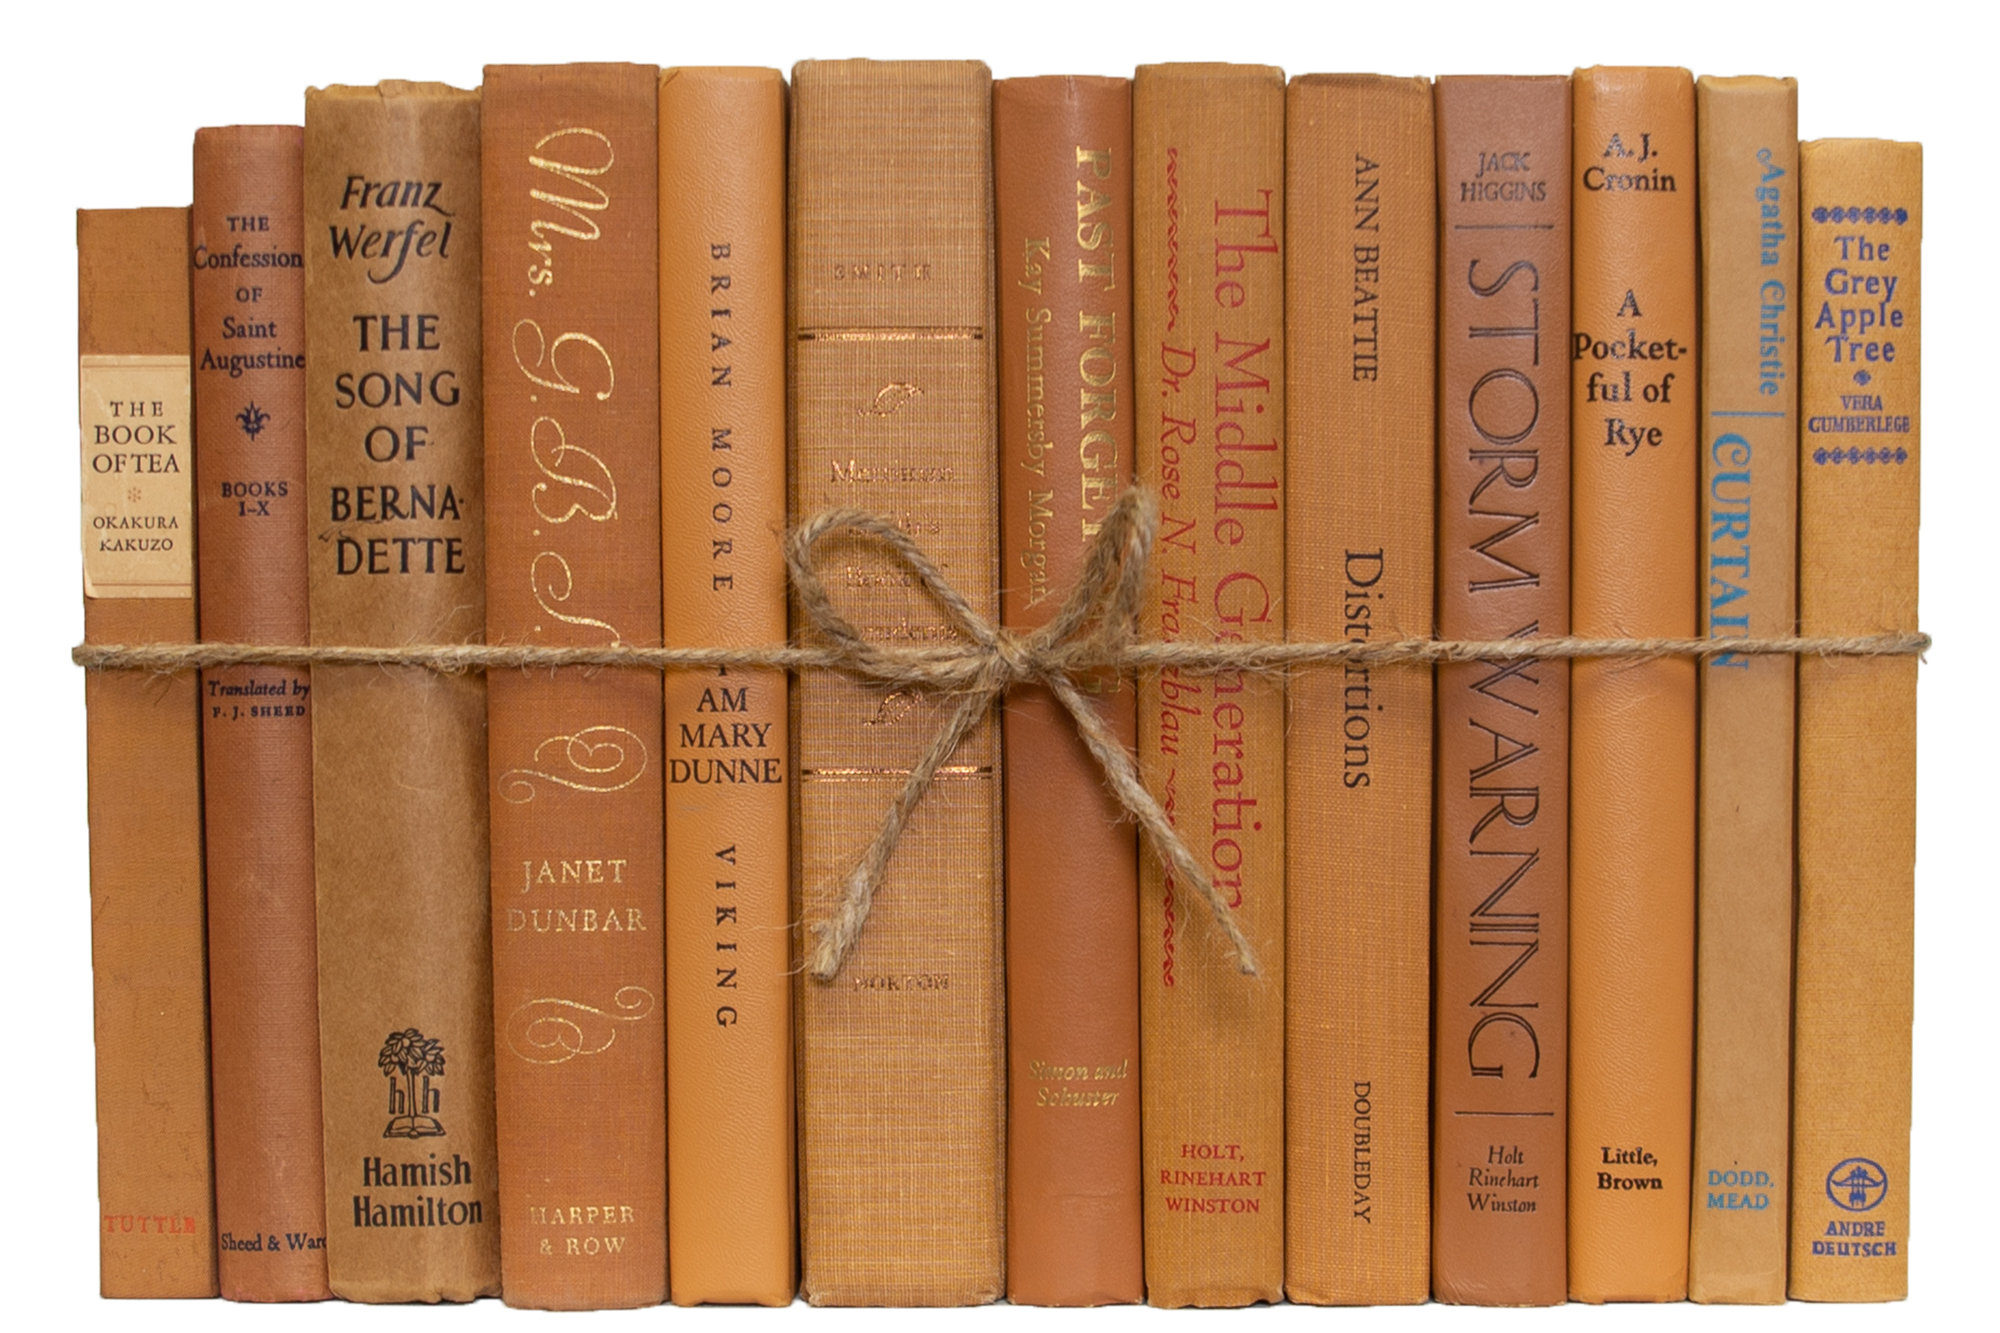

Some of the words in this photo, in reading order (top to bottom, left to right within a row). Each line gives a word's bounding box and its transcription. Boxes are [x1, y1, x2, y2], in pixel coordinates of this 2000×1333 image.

[1478, 152, 1531, 178] JACK
[1583, 166, 1677, 192] Cronin
[339, 174, 456, 218] Franz
[1354, 152, 1380, 233] ANN
[1459, 182, 1547, 203] HIGGINS
[1755, 146, 1787, 267] Agatha
[226, 216, 270, 232] THE
[528, 126, 615, 297] Mrs.
[1075, 144, 1116, 292] PAST
[329, 219, 453, 285] Werfel
[1213, 188, 1279, 309] The
[1832, 234, 1891, 261] The
[1018, 236, 1051, 295] Kay
[236, 287, 263, 303] OF
[1824, 267, 1899, 304] Grey
[710, 242, 732, 389] BRIAN
[1353, 243, 1380, 383] BEATTIE
[1616, 288, 1643, 317] A
[222, 316, 277, 340] Saint
[1814, 300, 1905, 335] Apple
[352, 314, 440, 352] THE
[1572, 327, 1688, 361] Pocket-
[1758, 278, 1786, 397] Christie
[1824, 334, 1896, 363] Tree
[200, 347, 306, 379] Augustine
[1161, 341, 1197, 398] Dr.
[334, 371, 460, 409] SONG
[1021, 307, 1053, 478] Summersby
[1586, 371, 1632, 404] ful
[1643, 372, 1675, 404] of
[110, 401, 164, 417] THE
[1840, 394, 1884, 411] VERA
[94, 425, 176, 445] BOOK
[1467, 258, 1541, 594] STORM
[1604, 417, 1664, 457] Rye
[1807, 415, 1911, 433] CUMBERLEGE
[364, 426, 428, 463] OF
[1213, 331, 1279, 547] Middle
[92, 453, 128, 474] OF
[131, 453, 180, 474] TEA
[1160, 410, 1197, 501] Rose
[221, 481, 288, 498] BOOKS
[710, 426, 734, 592] MOORE
[93, 517, 179, 530] OKAKURA
[1161, 511, 1197, 556] N.
[99, 537, 174, 552] KAKUZO
[335, 536, 466, 576] DETTE
[1020, 489, 1054, 605] Morgan
[1160, 568, 1202, 756] Frazblau
[208, 679, 287, 697] Translated
[292, 678, 311, 701] by
[696, 687, 749, 713] AM
[250, 705, 305, 718] SHEED
[679, 723, 773, 748] MARY
[669, 758, 783, 785] DUNNE
[1467, 619, 1541, 1080] WARNING
[521, 859, 627, 894] JANET
[505, 908, 648, 933] DUNBAR
[715, 844, 738, 1029] VIKING
[1028, 1060, 1089, 1081] Simon
[1094, 1058, 1129, 1080] and
[1036, 1086, 1120, 1108] Schuster
[1180, 1144, 1245, 1162] HOLT,
[1353, 1080, 1372, 1224] DOUBLEDAY
[1487, 1145, 1525, 1165] Holt
[1600, 1146, 1659, 1168] Little,
[362, 1152, 472, 1188] Hamish
[1160, 1170, 1267, 1187] RINEHART
[1468, 1167, 1540, 1189] Rinehart
[1596, 1172, 1664, 1191] Brown
[353, 1195, 483, 1228] Hamilton
[529, 1205, 635, 1225] HARPER
[1165, 1197, 1260, 1214] WINSTON
[1466, 1192, 1537, 1213] Winston
[1706, 1193, 1770, 1211] MEAD
[104, 1215, 196, 1234] TUTTLE
[1824, 1220, 1886, 1237] ANDRE
[220, 1233, 262, 1252] Sheed
[267, 1236, 280, 1252] &
[540, 1238, 553, 1256] &
[566, 1236, 626, 1256] ROW
[1811, 1240, 1898, 1257] DEUTSCH
